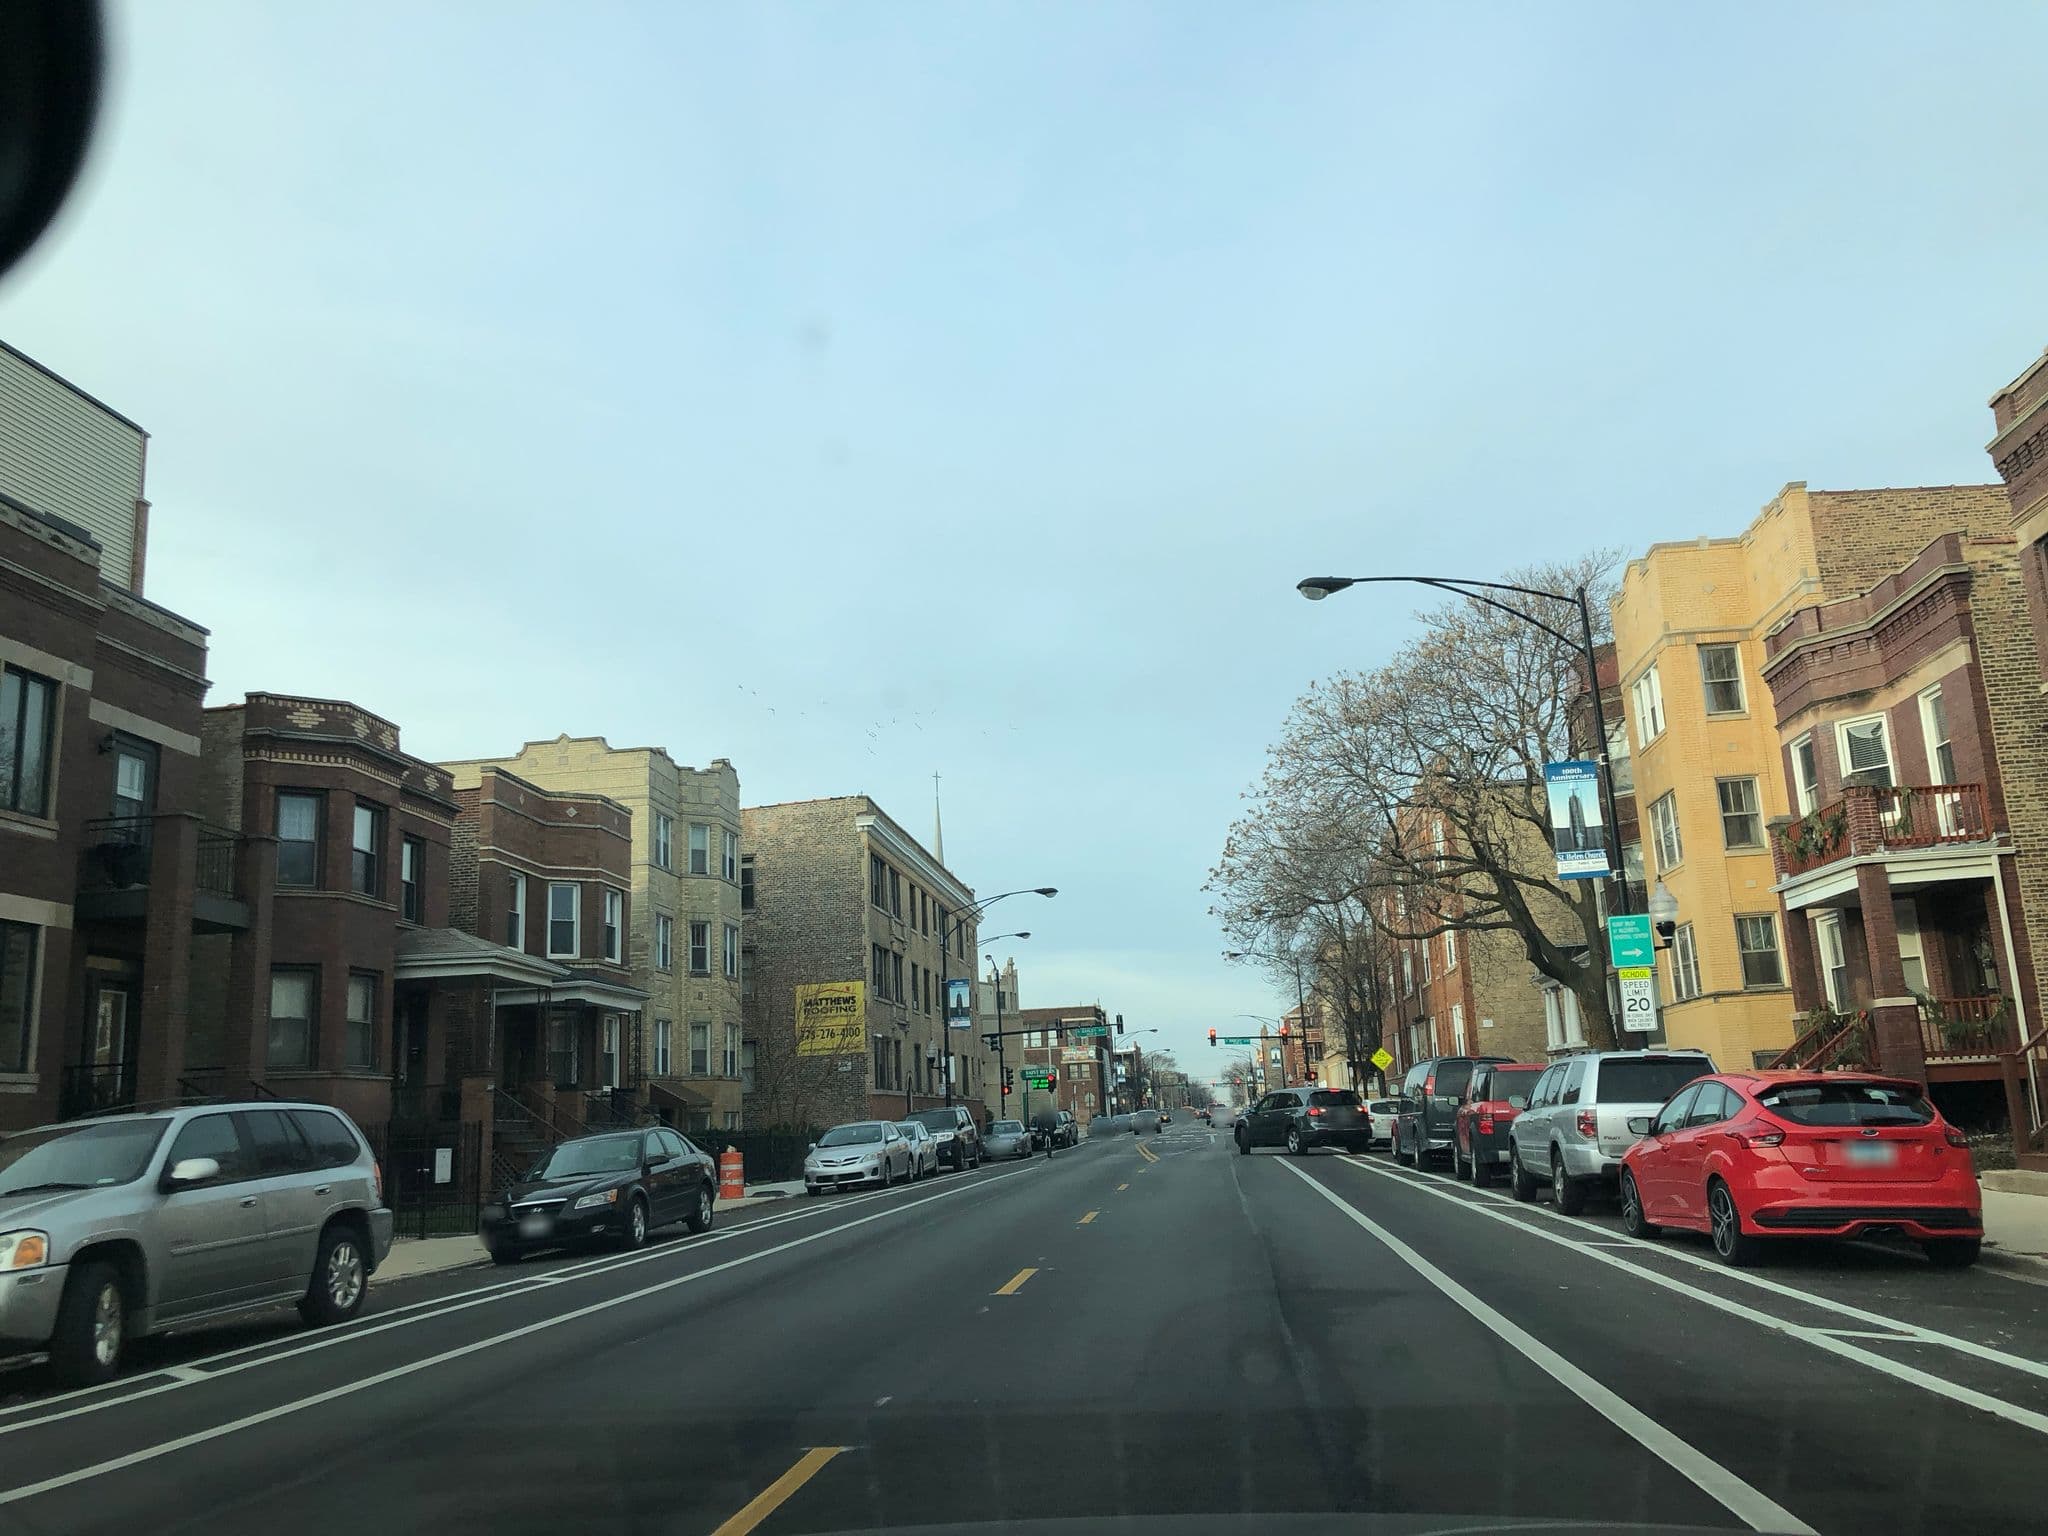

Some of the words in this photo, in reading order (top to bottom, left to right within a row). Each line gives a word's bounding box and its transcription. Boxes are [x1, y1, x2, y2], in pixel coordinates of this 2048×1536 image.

[1550, 773, 1596, 781] Anniversary
[1584, 850, 1607, 859] Church
[1623, 981, 1649, 989] SPEED
[1627, 989, 1647, 997] LIMIT
[803, 996, 856, 1007] MATTHEWS
[1626, 997, 1650, 1012] 20
[803, 1005, 857, 1015] ROOFING
